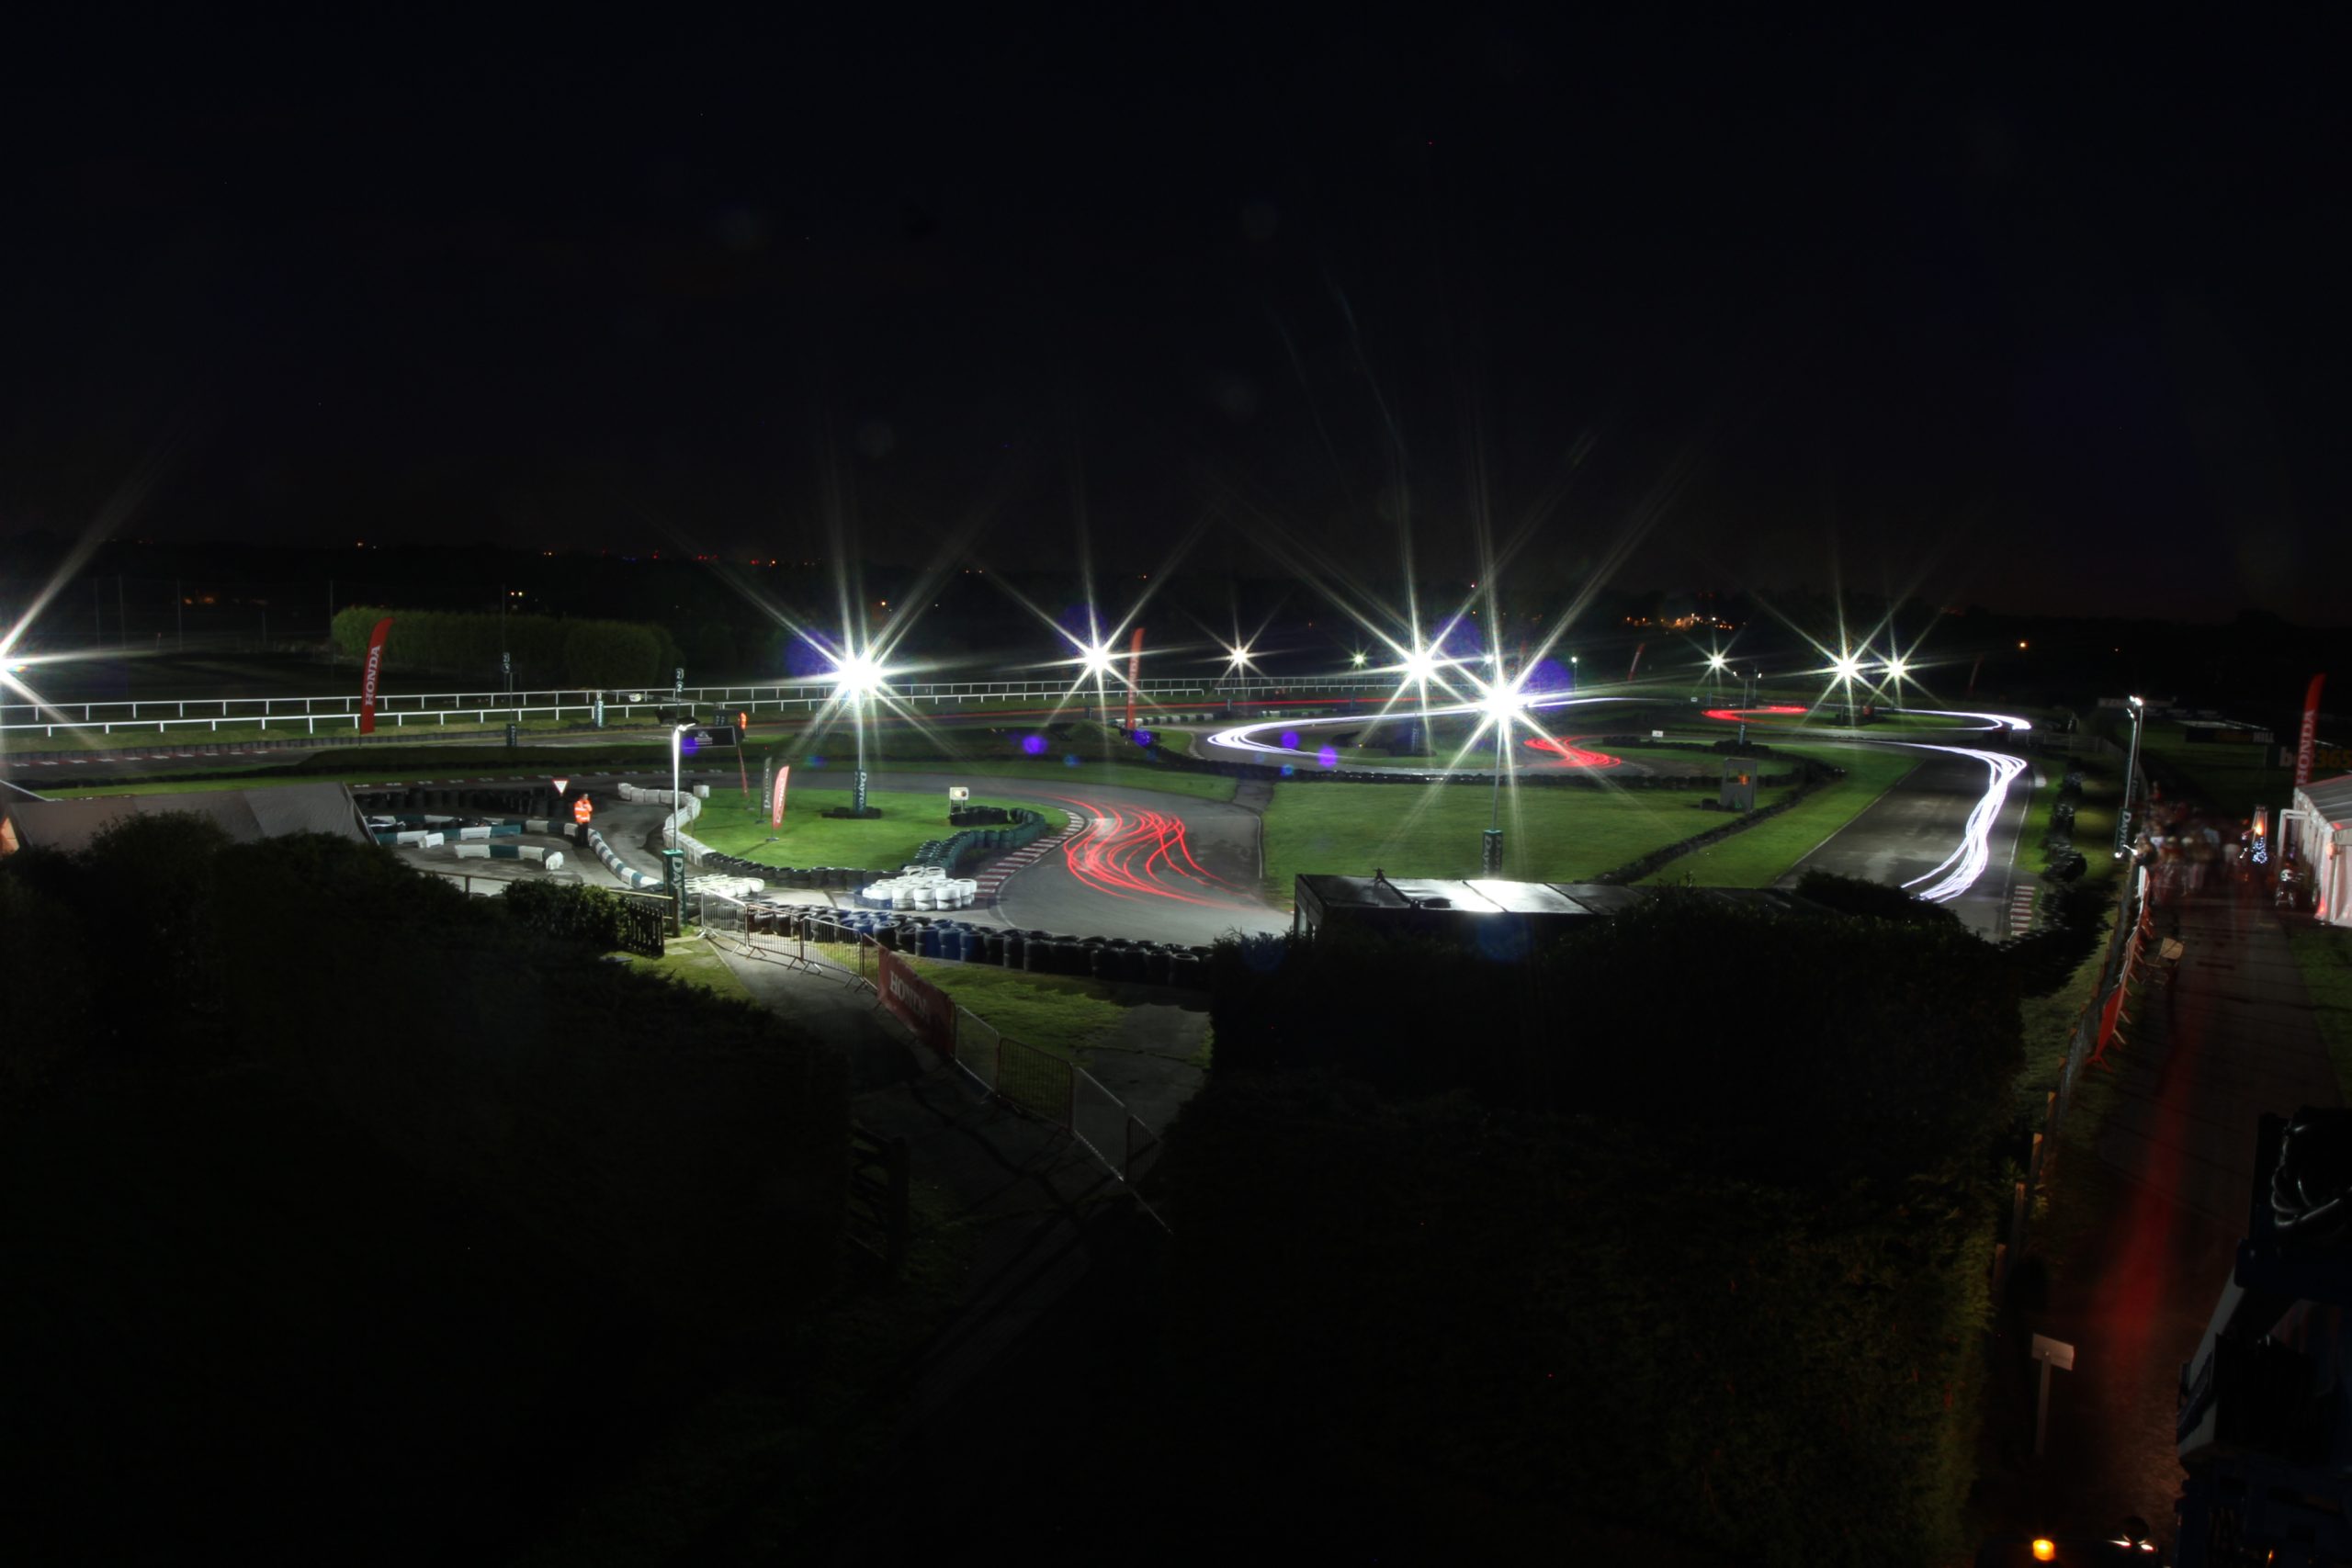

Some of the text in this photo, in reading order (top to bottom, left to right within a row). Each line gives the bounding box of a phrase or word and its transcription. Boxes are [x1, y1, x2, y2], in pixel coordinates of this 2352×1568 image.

[365, 644, 381, 705] HONDA
[2278, 745, 2352, 769] b365
[2295, 710, 2315, 784] HONDA
